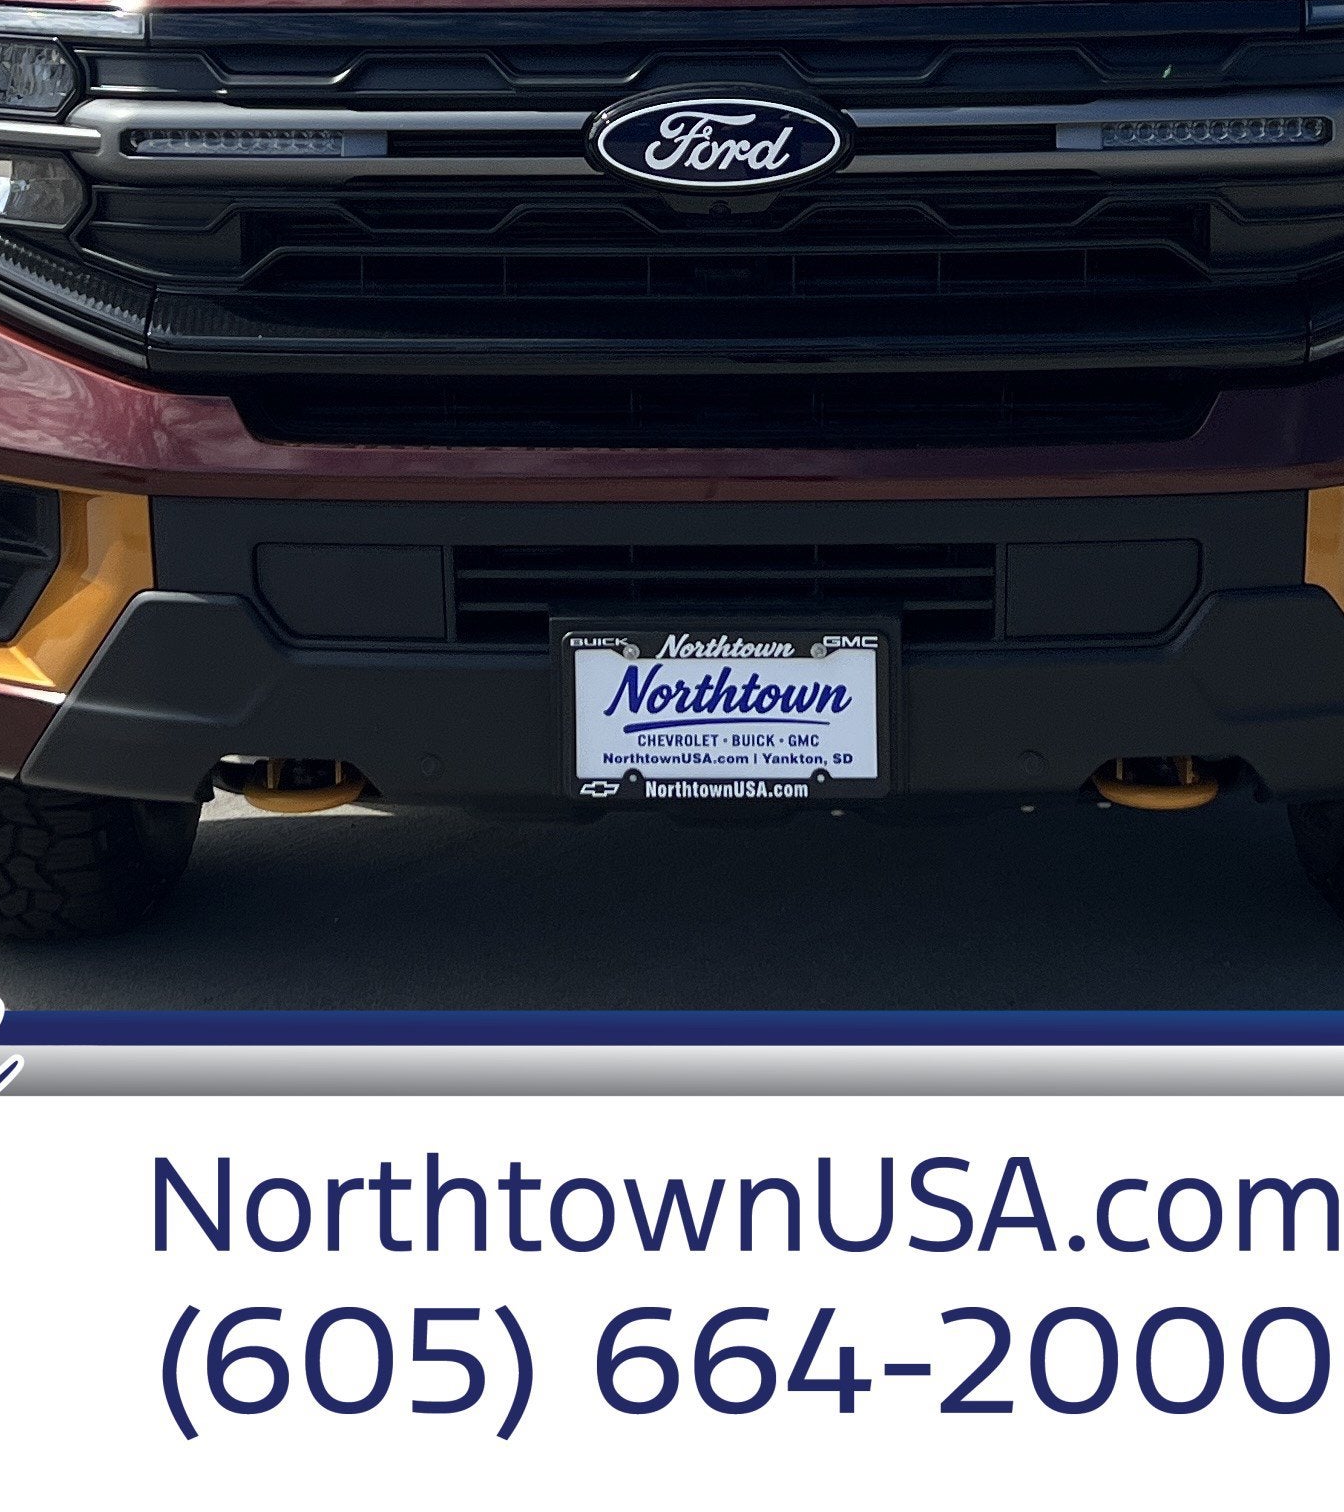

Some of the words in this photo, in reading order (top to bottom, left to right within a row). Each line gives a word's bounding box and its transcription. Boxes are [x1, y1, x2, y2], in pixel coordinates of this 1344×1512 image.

[644, 111, 794, 171] Ford
[569, 637, 628, 647] BUICK
[656, 633, 796, 659] Northtown
[822, 635, 879, 649] GMC
[603, 663, 853, 717] Northtown
[637, 734, 719, 748] CHEVROLET
[731, 734, 776, 748] BUICK
[788, 734, 820, 748] GMC
[603, 752, 749, 765] NorthtownUSA.com
[762, 752, 828, 767] Yankton,
[832, 752, 854, 765] SD
[645, 780, 809, 799] NorthtownUSA.com
